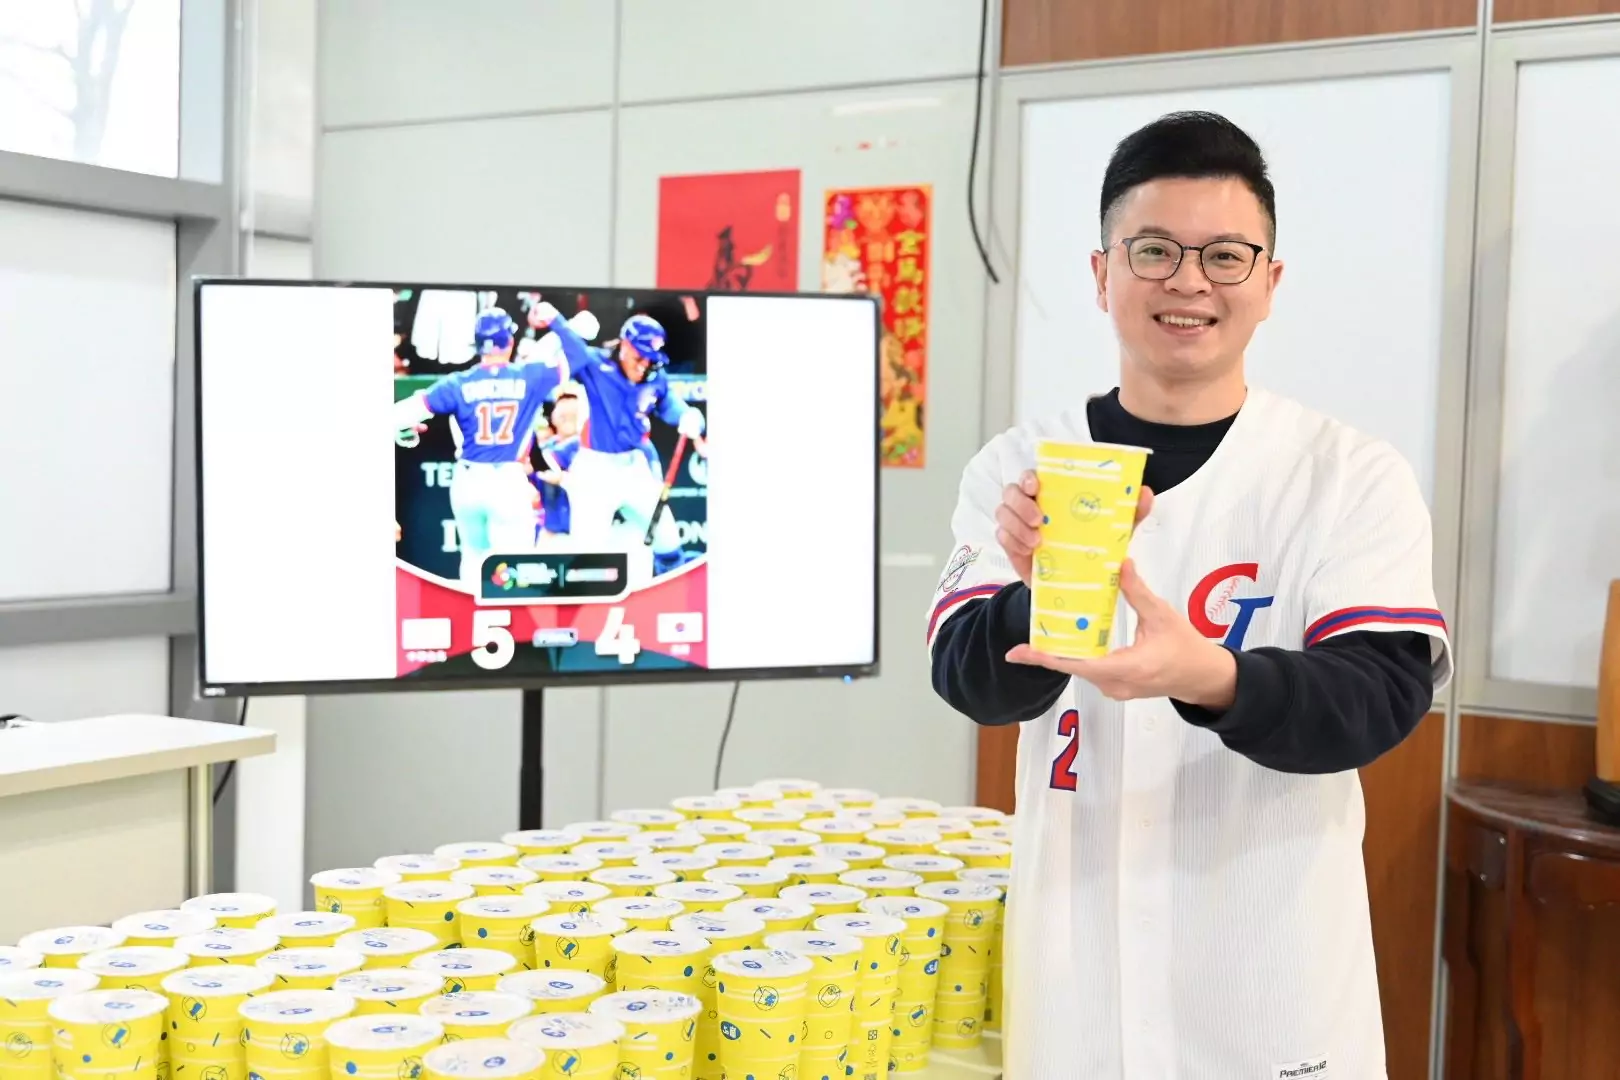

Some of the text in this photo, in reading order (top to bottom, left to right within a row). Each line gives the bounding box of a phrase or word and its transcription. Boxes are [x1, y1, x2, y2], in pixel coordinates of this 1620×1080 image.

[475, 401, 518, 445] 17
[470, 608, 515, 671] 5
[594, 606, 641, 666] 4
[1049, 709, 1079, 792] 2
